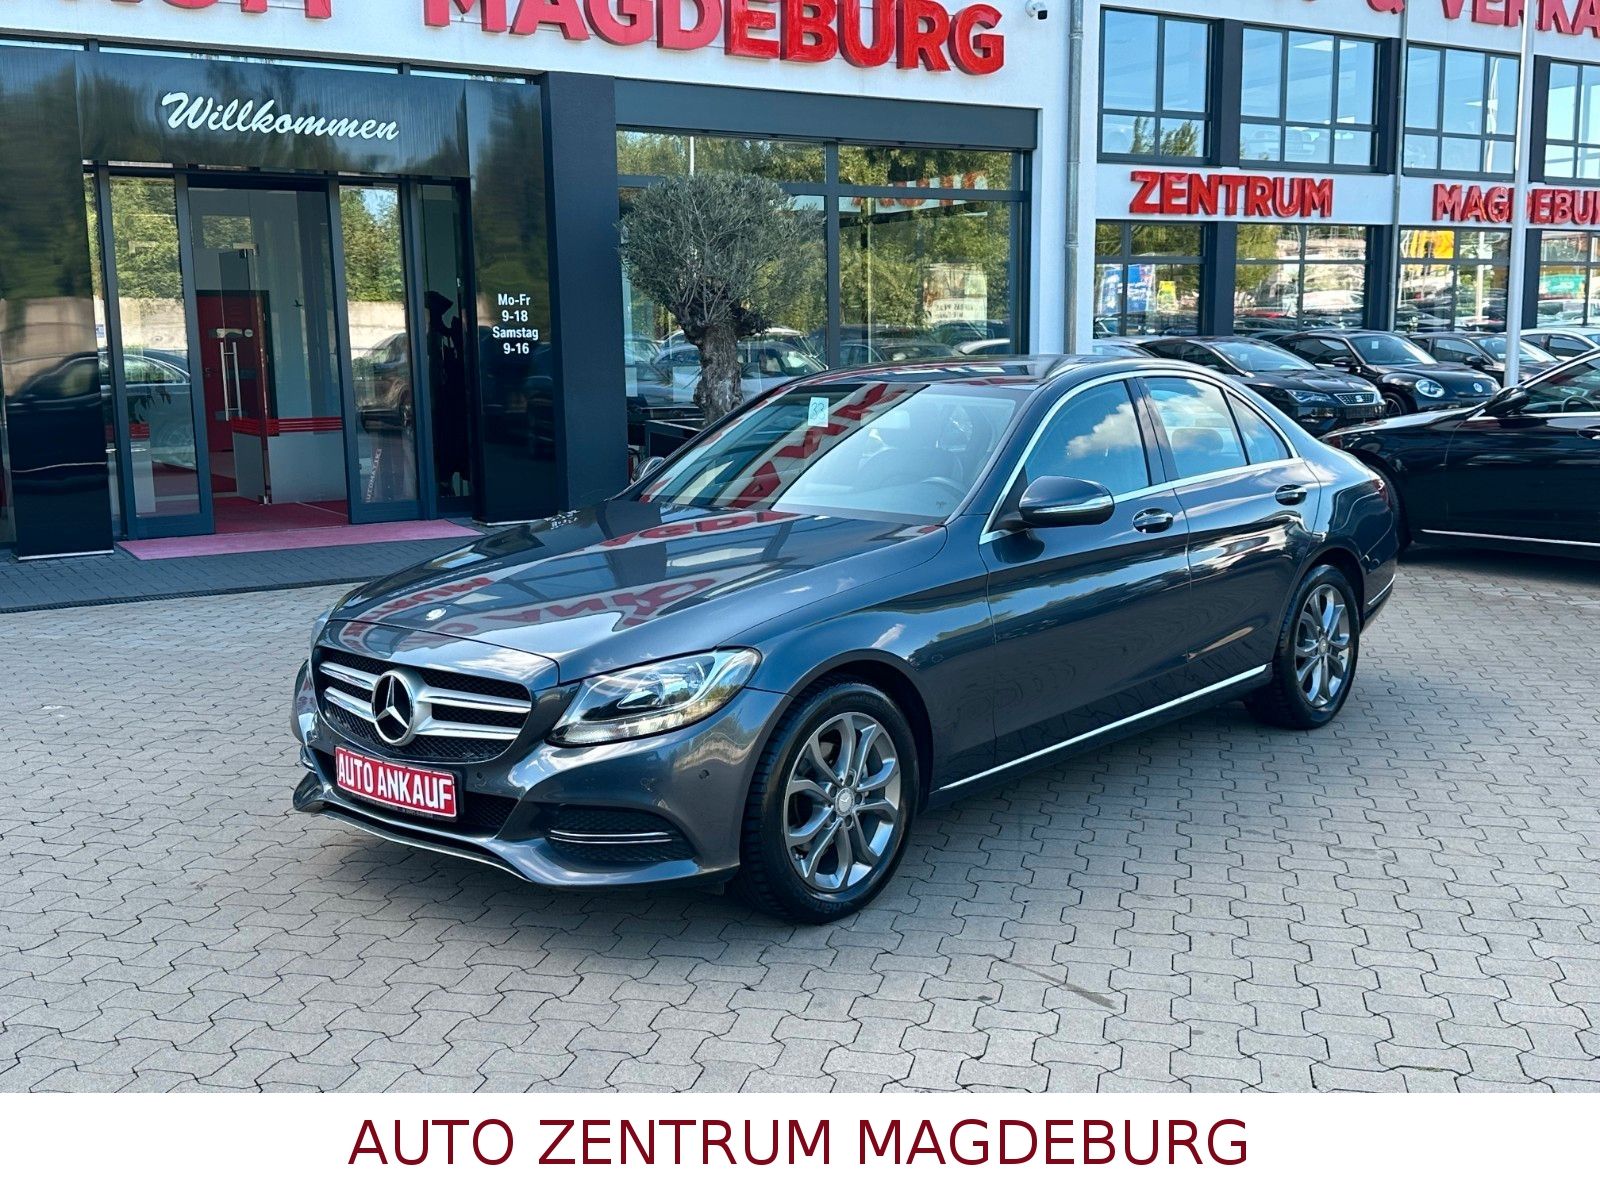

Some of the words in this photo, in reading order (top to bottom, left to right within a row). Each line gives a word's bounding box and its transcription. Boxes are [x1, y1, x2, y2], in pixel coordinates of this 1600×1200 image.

[162, 92, 400, 141] Willkommen
[1129, 170, 1334, 218] ZENTRUM
[1432, 183, 1600, 225] MAGEBU
[498, 293, 531, 306] Mo-Fr
[501, 309, 529, 322] 9-18
[492, 325, 539, 341] Samstag
[503, 342, 530, 355] 9-16
[338, 753, 374, 794] AUTO
[377, 765, 453, 810] ANKAUF
